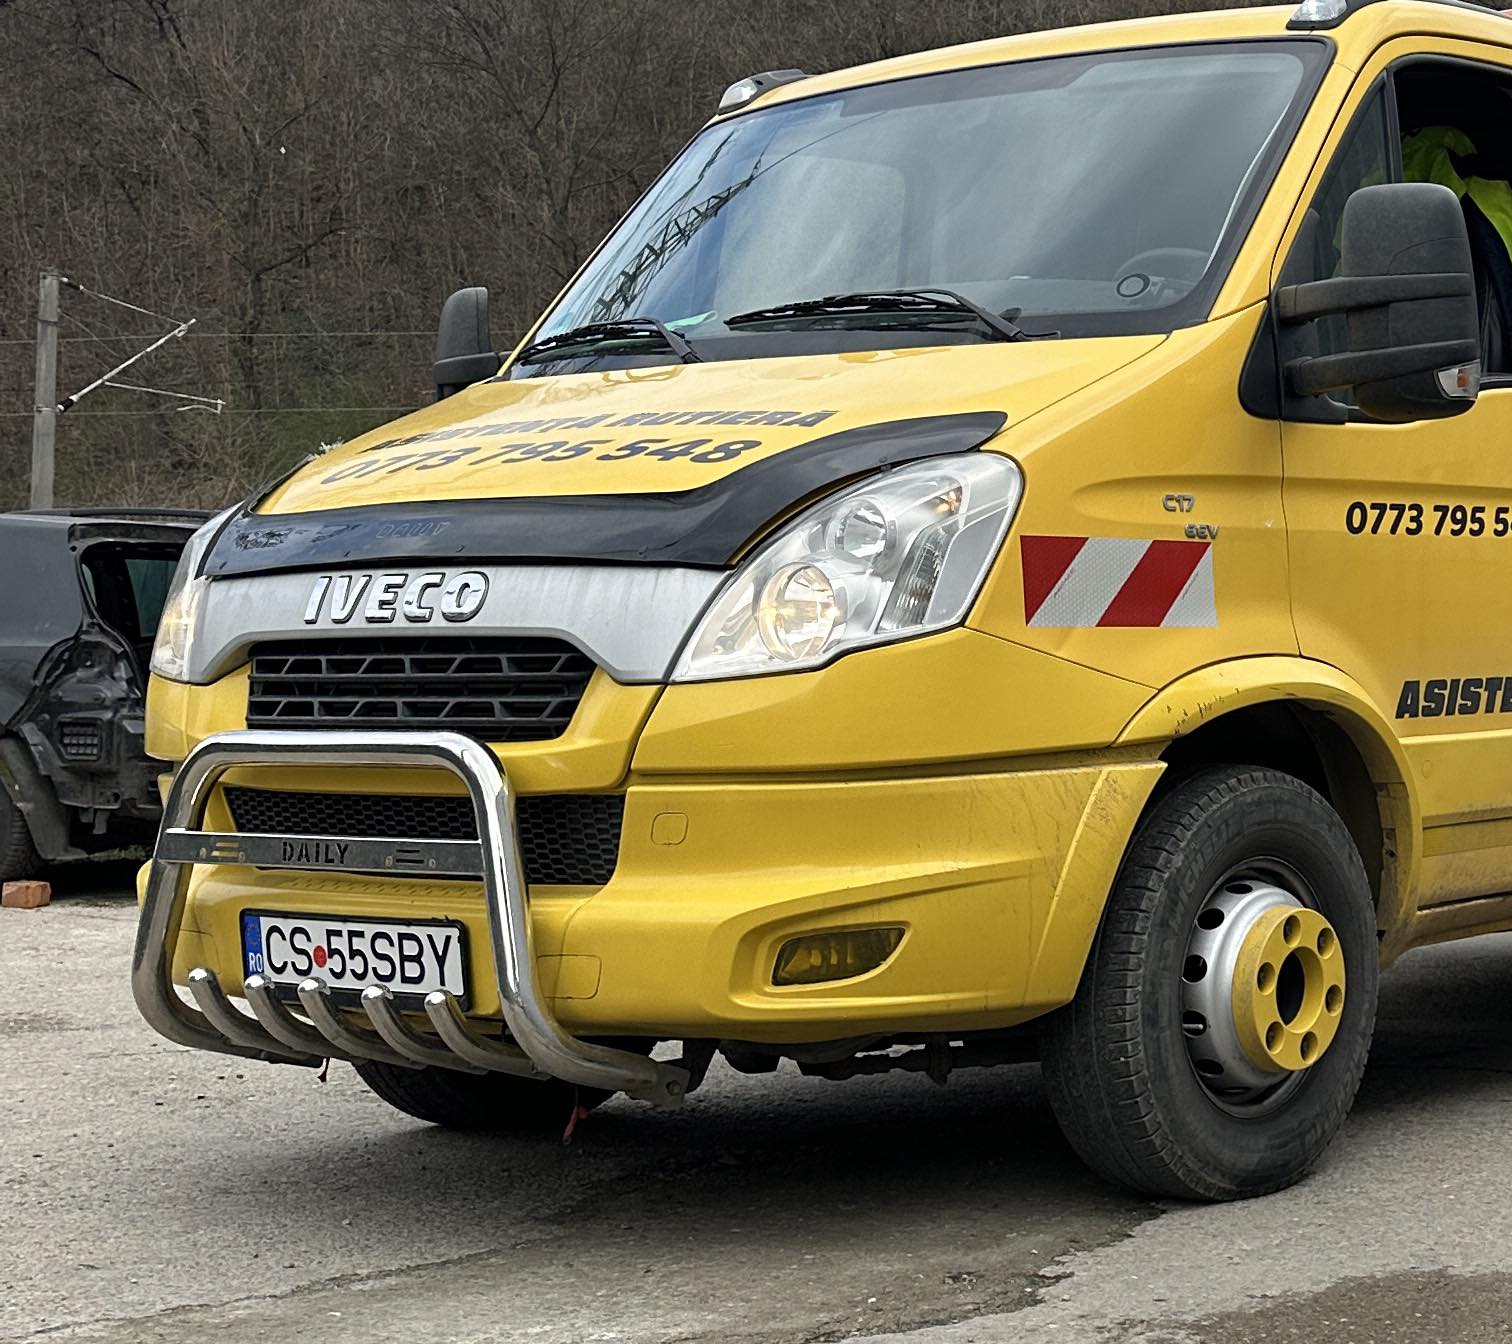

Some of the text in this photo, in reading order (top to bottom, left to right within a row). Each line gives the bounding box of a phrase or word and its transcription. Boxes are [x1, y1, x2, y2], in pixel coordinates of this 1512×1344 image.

[467, 439, 616, 466] 795
[595, 439, 762, 463] 548
[1345, 501, 1424, 535] 0773
[1433, 504, 1486, 536] 795
[303, 571, 490, 624] IVECO
[282, 841, 350, 865] DAILY
